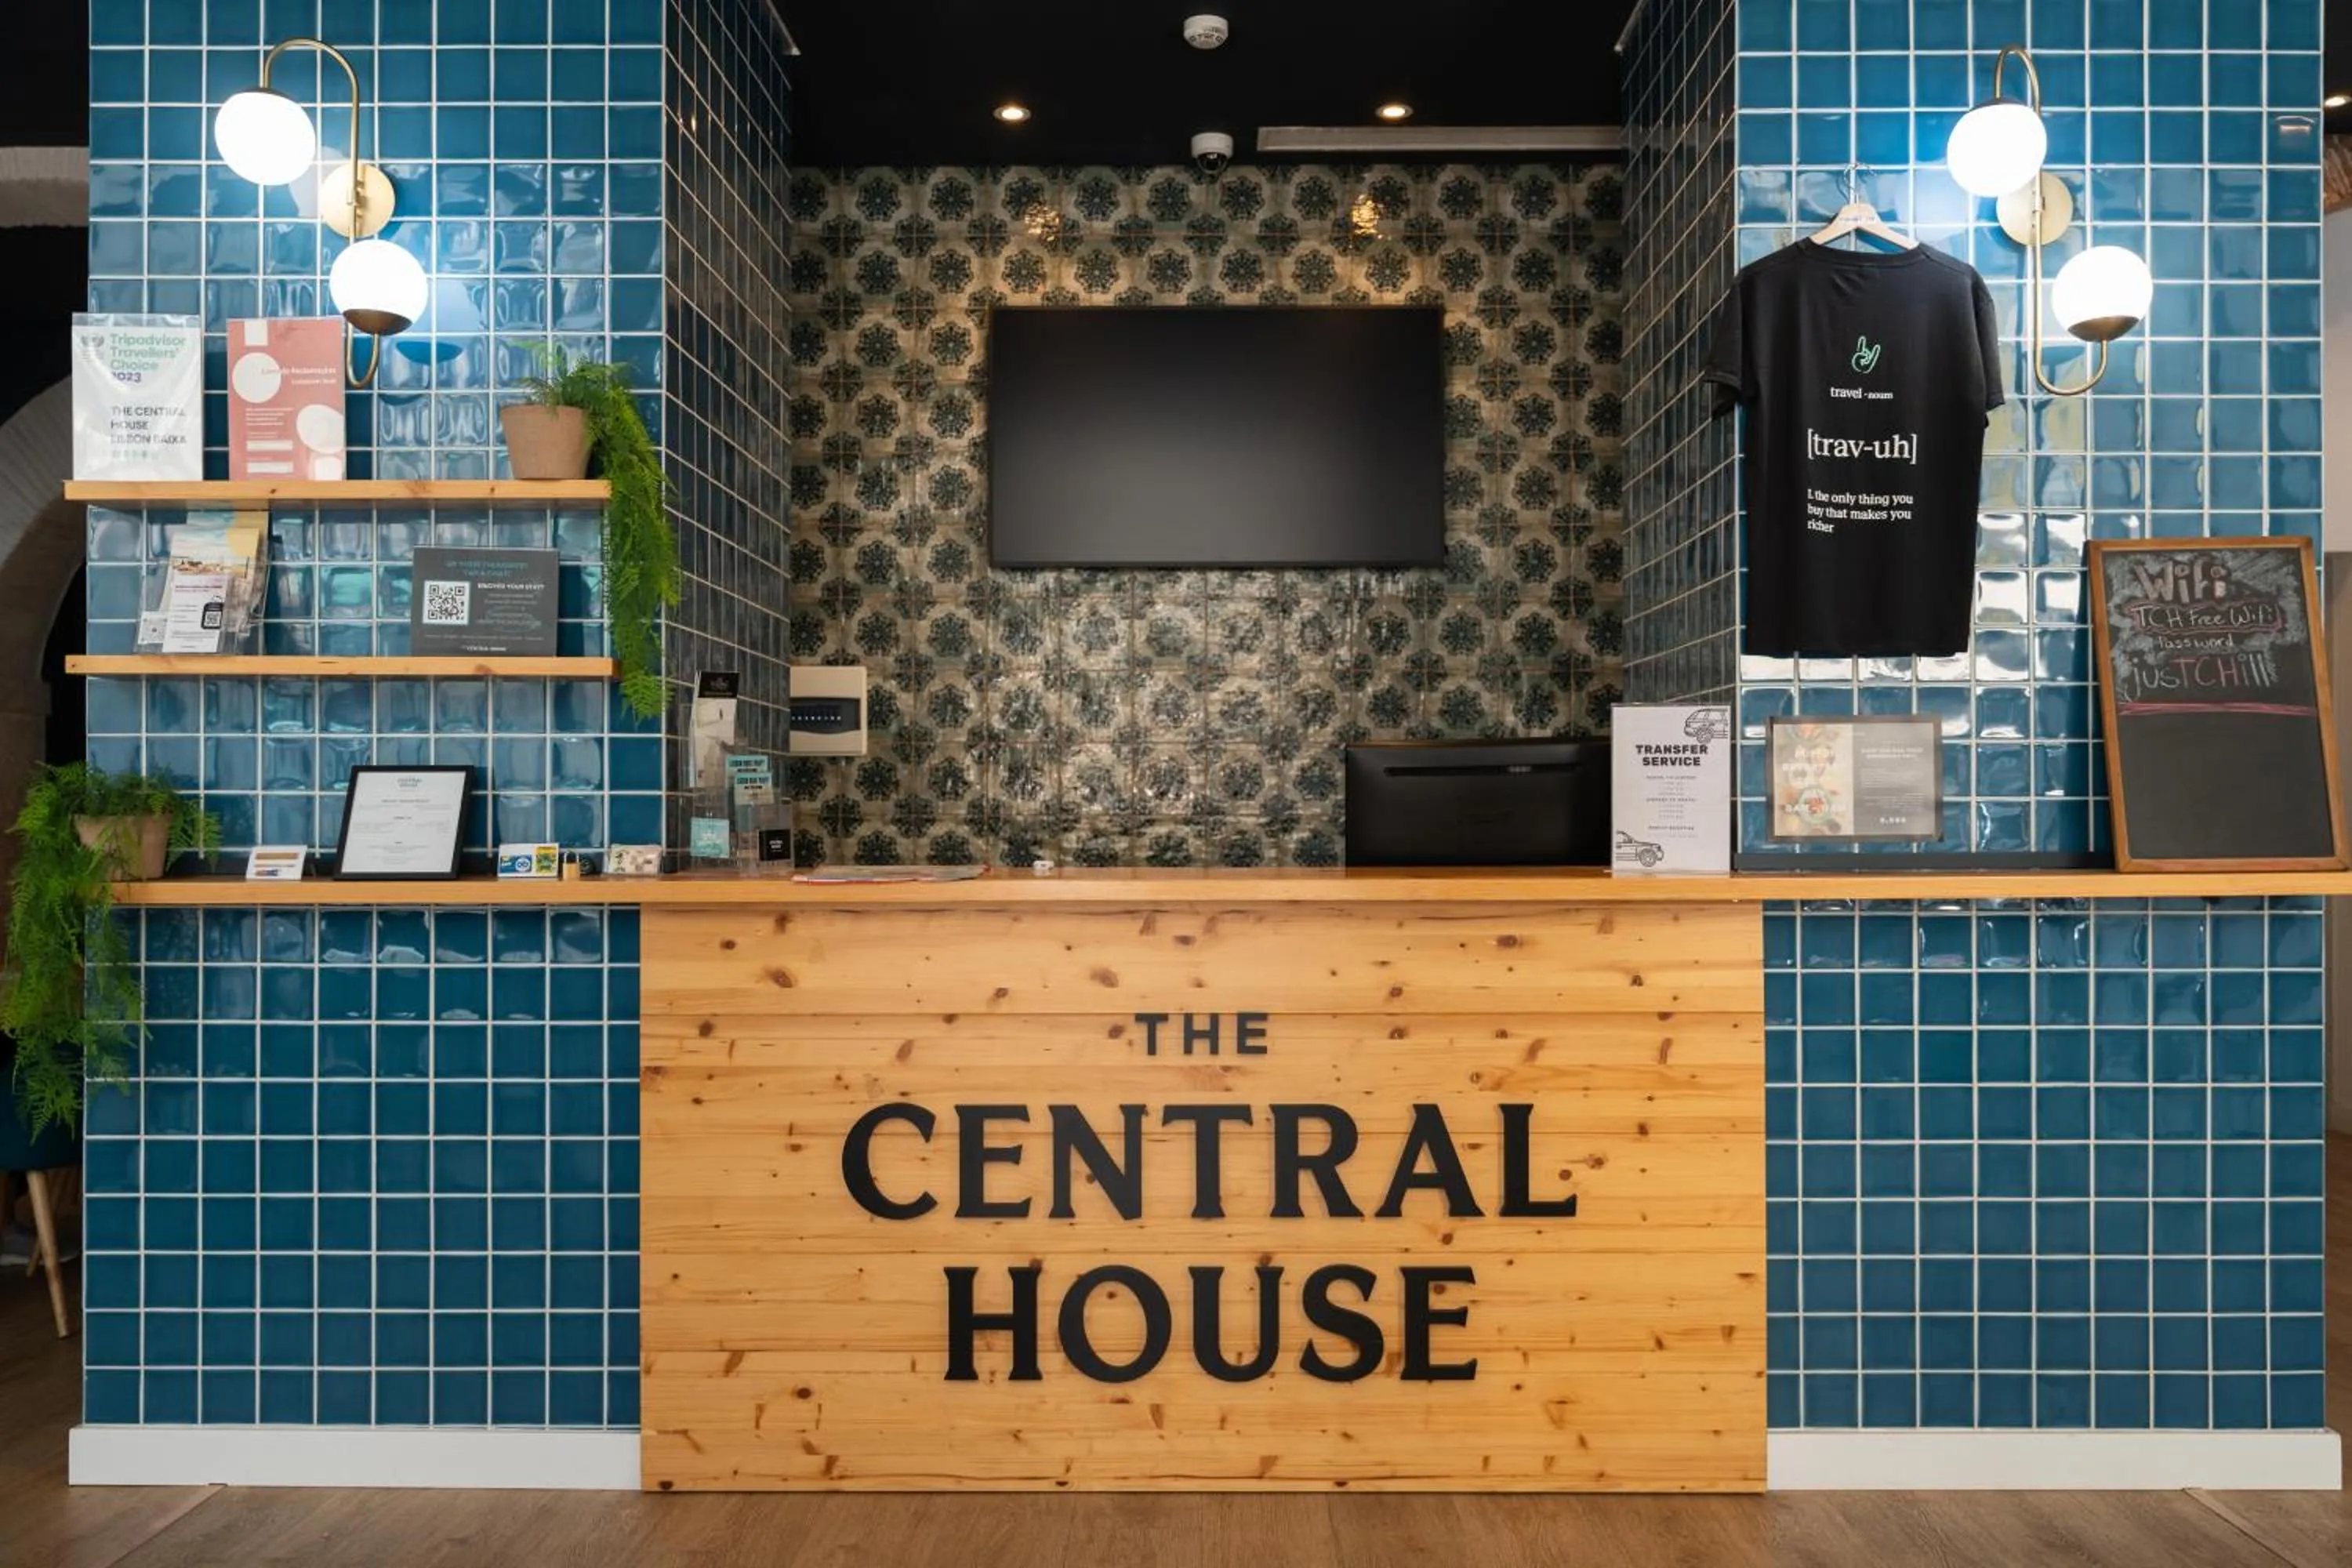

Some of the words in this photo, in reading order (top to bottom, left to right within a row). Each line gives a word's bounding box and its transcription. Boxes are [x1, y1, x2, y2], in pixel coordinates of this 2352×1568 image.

[110, 332, 186, 347] Tripadvisor
[111, 360, 159, 371] Choice
[1831, 387, 1862, 399] travel
[111, 407, 132, 416] THE
[111, 421, 148, 430] HOUSE
[1807, 428, 1917, 465] [trav-uh]
[1815, 490, 1829, 503] the
[1831, 492, 1857, 506] only
[1858, 494, 1890, 507] thing
[1892, 495, 1914, 506] you
[1807, 503, 1824, 517] buy
[1826, 507, 1848, 518] that
[1849, 509, 1888, 520] makes
[1889, 510, 1912, 521] you
[1807, 519, 1835, 533] richer
[2131, 605, 2183, 627] TCH
[1635, 745, 1708, 755] TRANSFER
[1642, 756, 1701, 767] SERVICE
[1134, 1012, 1269, 1056] THE
[841, 1102, 1577, 1221] CENTRAL
[943, 1264, 1478, 1384] HOUSE
